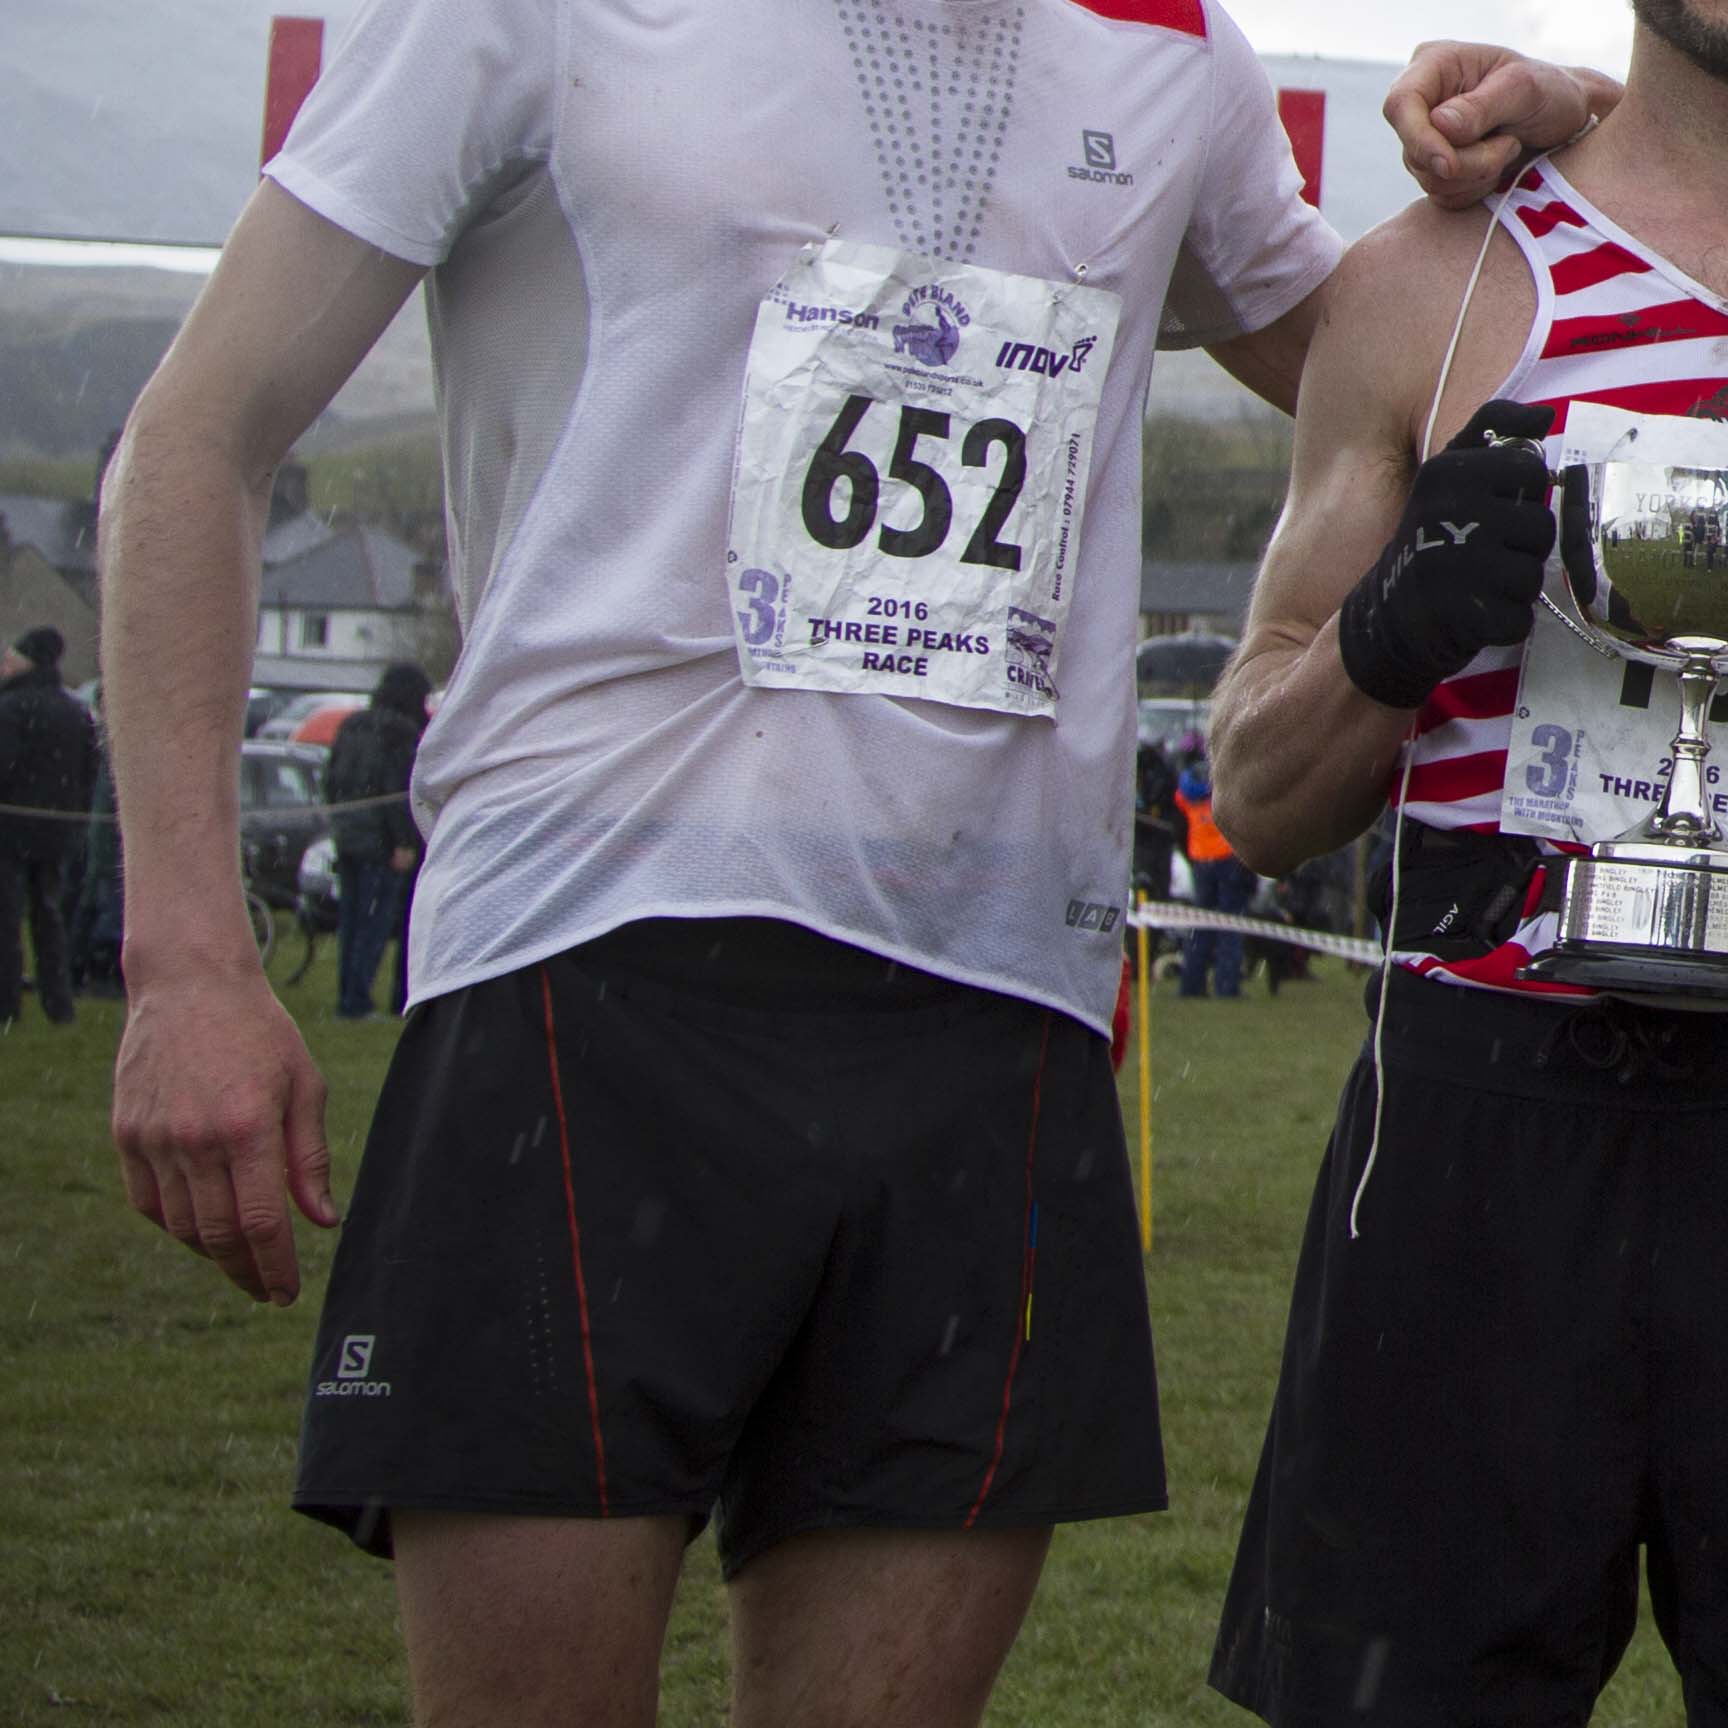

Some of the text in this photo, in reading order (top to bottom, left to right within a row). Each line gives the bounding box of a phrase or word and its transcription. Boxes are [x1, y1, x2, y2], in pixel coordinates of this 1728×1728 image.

[1067, 167, 1133, 186] salomon
[786, 301, 880, 331] Hanson
[930, 284, 971, 327] BLAND
[1066, 433, 1080, 476] 729071
[801, 394, 1027, 572] 652
[1063, 479, 1076, 516] 07944
[1055, 527, 1069, 570] Control
[1051, 573, 1063, 601] Race
[737, 568, 779, 646] 3
[867, 597, 929, 621] 2016
[808, 618, 990, 654] THREE PEAKS
[862, 652, 929, 677] RACE
[1526, 724, 1573, 798] 3
[1566, 728, 1586, 801] PEAKS
[1600, 773, 1671, 803] THRE
[316, 1381, 391, 1397] salomon
